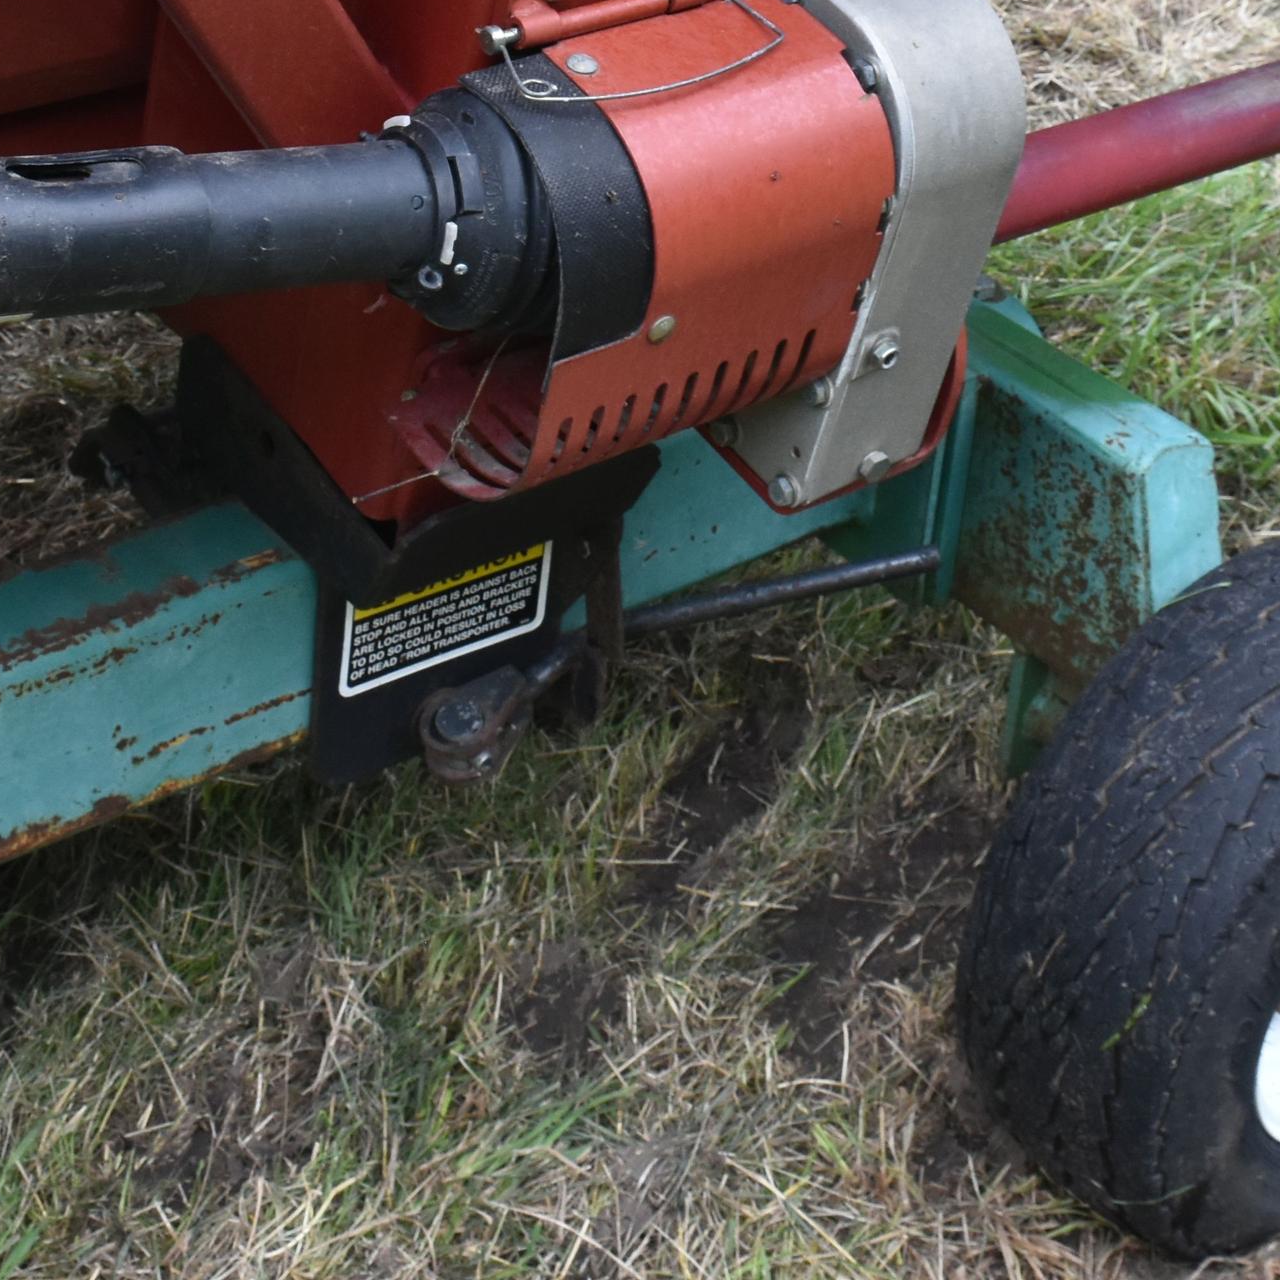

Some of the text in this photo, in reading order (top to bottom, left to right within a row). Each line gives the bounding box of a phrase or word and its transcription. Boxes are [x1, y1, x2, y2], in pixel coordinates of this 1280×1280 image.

[352, 587, 532, 657] ARE LOCKED IN POSITION. FAILURE
[354, 575, 537, 646] STOP AND ALL PINS AND BRACKETS
[355, 563, 538, 634] BE SURE HEADER IS AGAINST BACK
[351, 668, 366, 681] OF
[368, 657, 397, 674] HEAD
[433, 618, 510, 652] TRANSPORTER.
[352, 599, 526, 669] TO DO SO COULD RESULT IN LOSS
